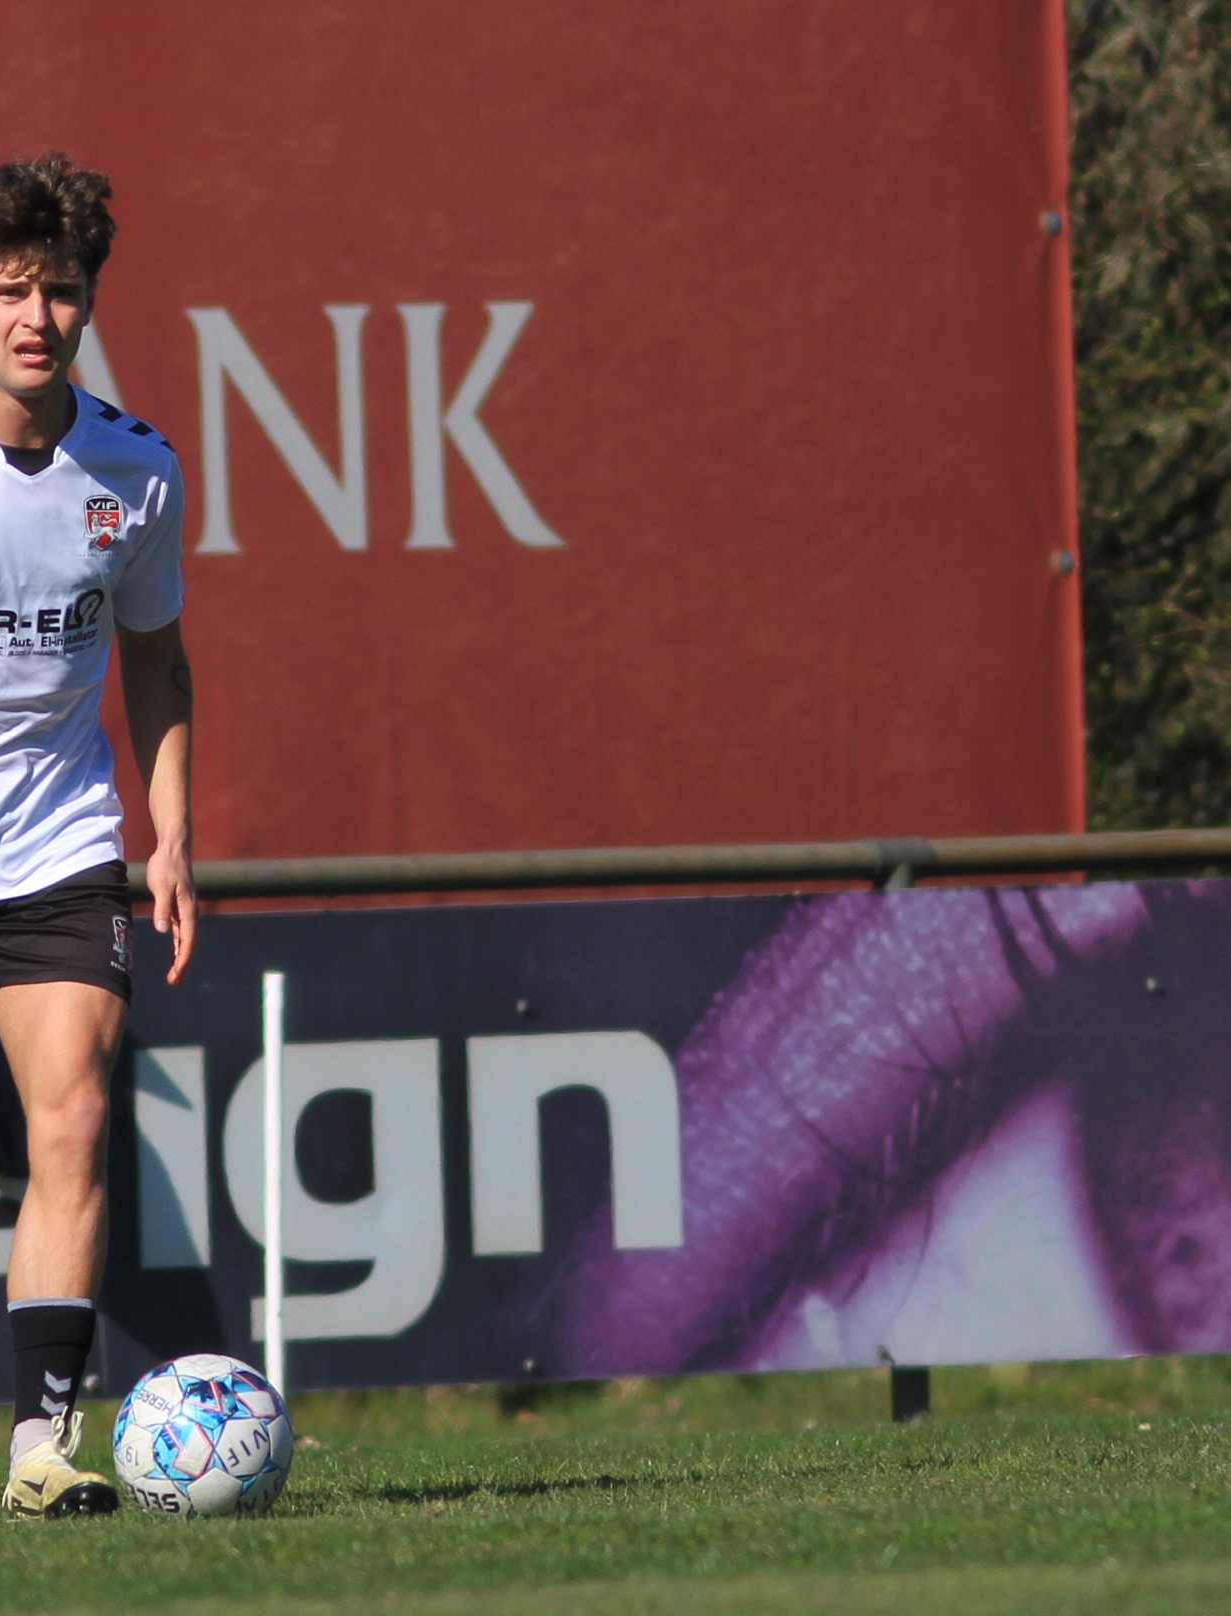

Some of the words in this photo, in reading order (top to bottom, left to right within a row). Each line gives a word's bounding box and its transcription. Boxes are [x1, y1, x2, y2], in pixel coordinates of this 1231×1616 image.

[89, 501, 117, 510] VIF
[135, 1389, 176, 1416] HERRE
[125, 1446, 140, 1467] 19
[226, 1428, 269, 1468] VIF
